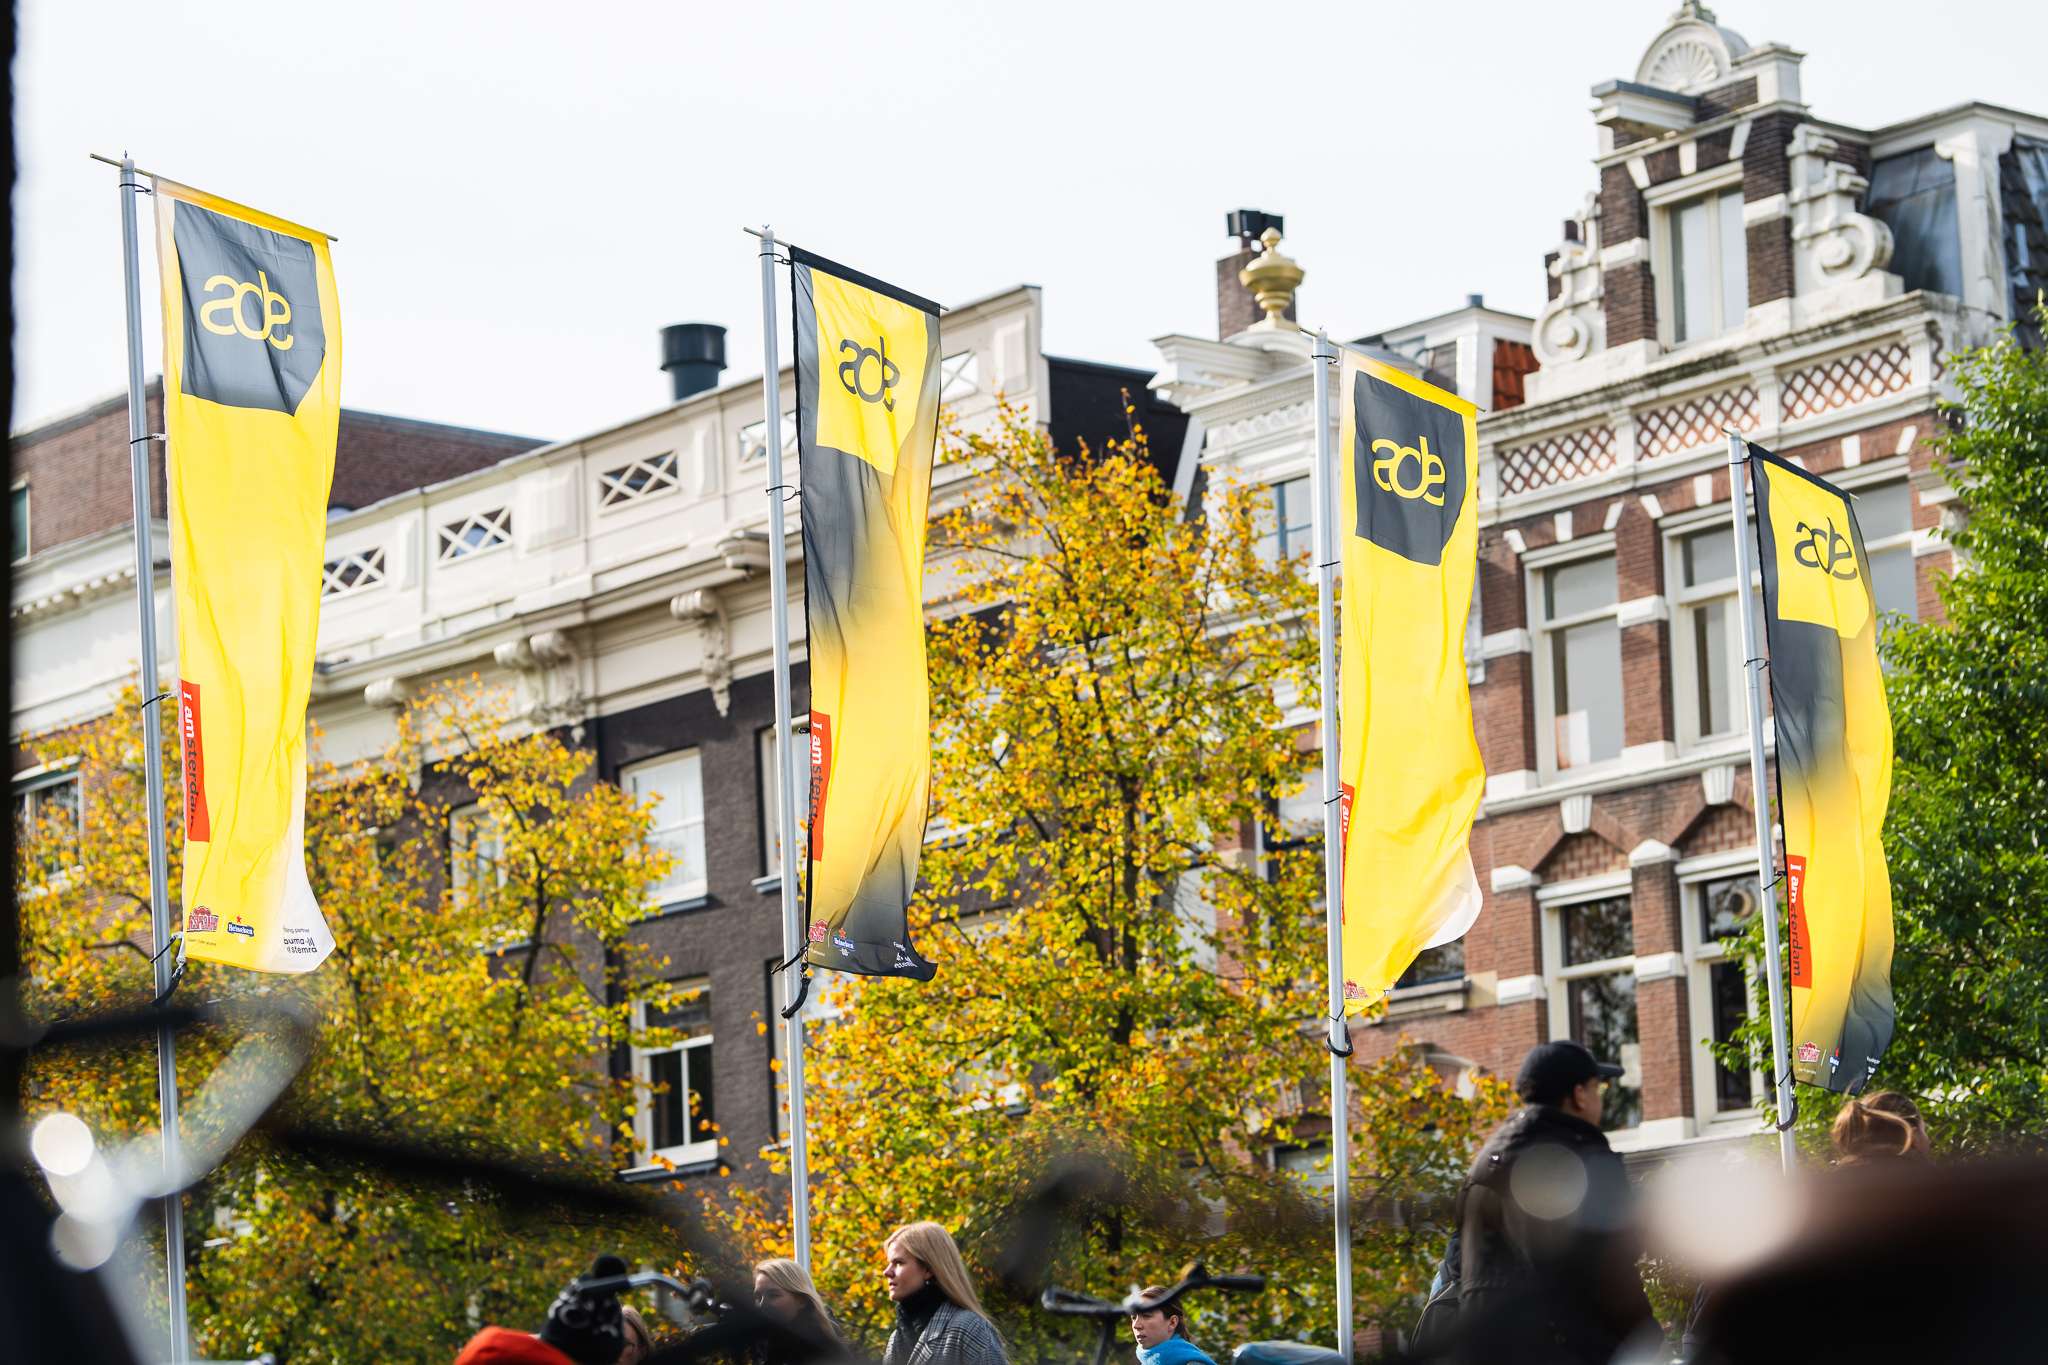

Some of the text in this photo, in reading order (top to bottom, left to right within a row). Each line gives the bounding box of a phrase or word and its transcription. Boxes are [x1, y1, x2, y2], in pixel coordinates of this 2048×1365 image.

[200, 270, 294, 351] ade
[839, 335, 900, 412] ade
[1371, 435, 1446, 507] ade
[1794, 516, 1858, 580] ade
[183, 691, 192, 701] I
[812, 720, 823, 730] I
[1790, 876, 1803, 977] amsterdam
